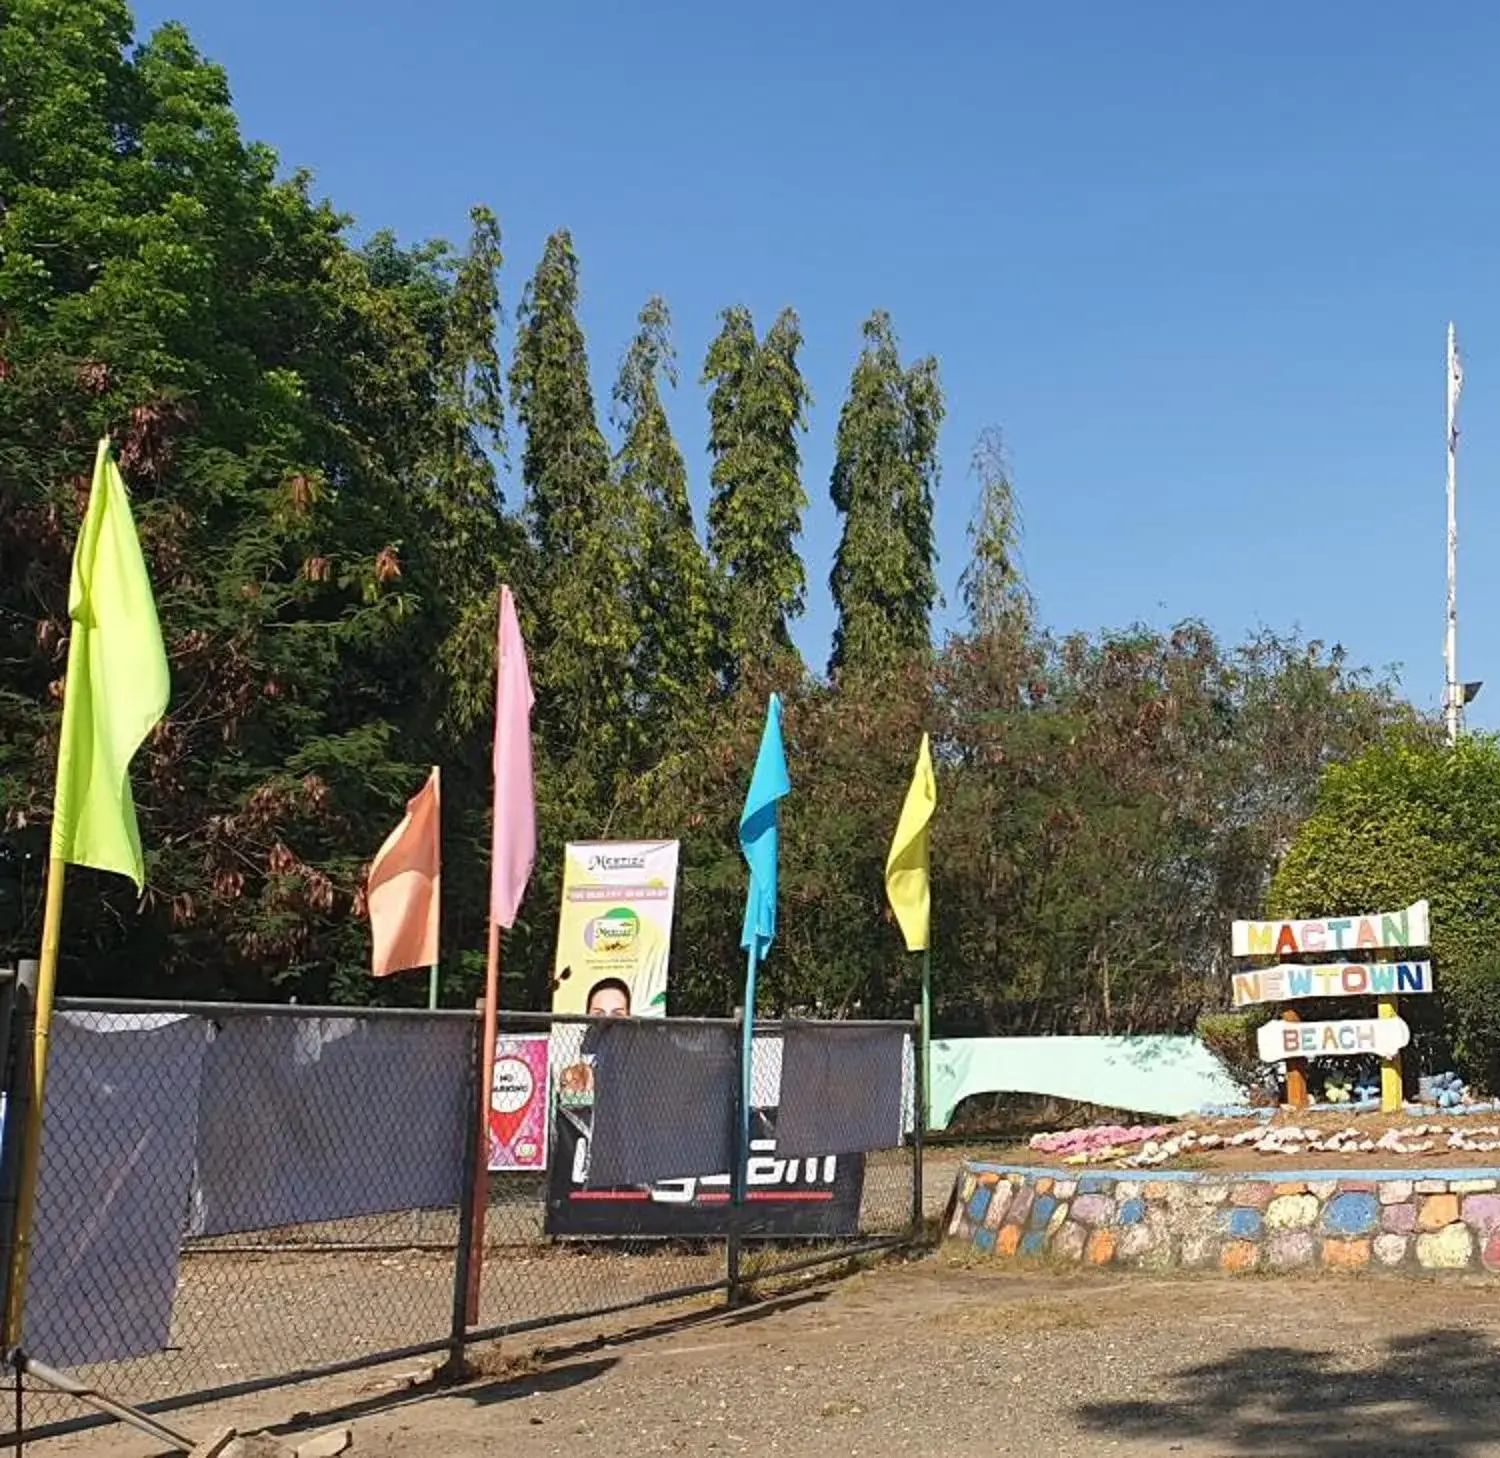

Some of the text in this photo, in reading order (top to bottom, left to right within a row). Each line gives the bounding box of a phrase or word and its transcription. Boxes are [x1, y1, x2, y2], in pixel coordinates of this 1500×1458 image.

[1247, 910, 1410, 954] MACTAN
[1234, 964, 1424, 1001] NEWTOWN
[1282, 1026, 1376, 1052] BEACH
